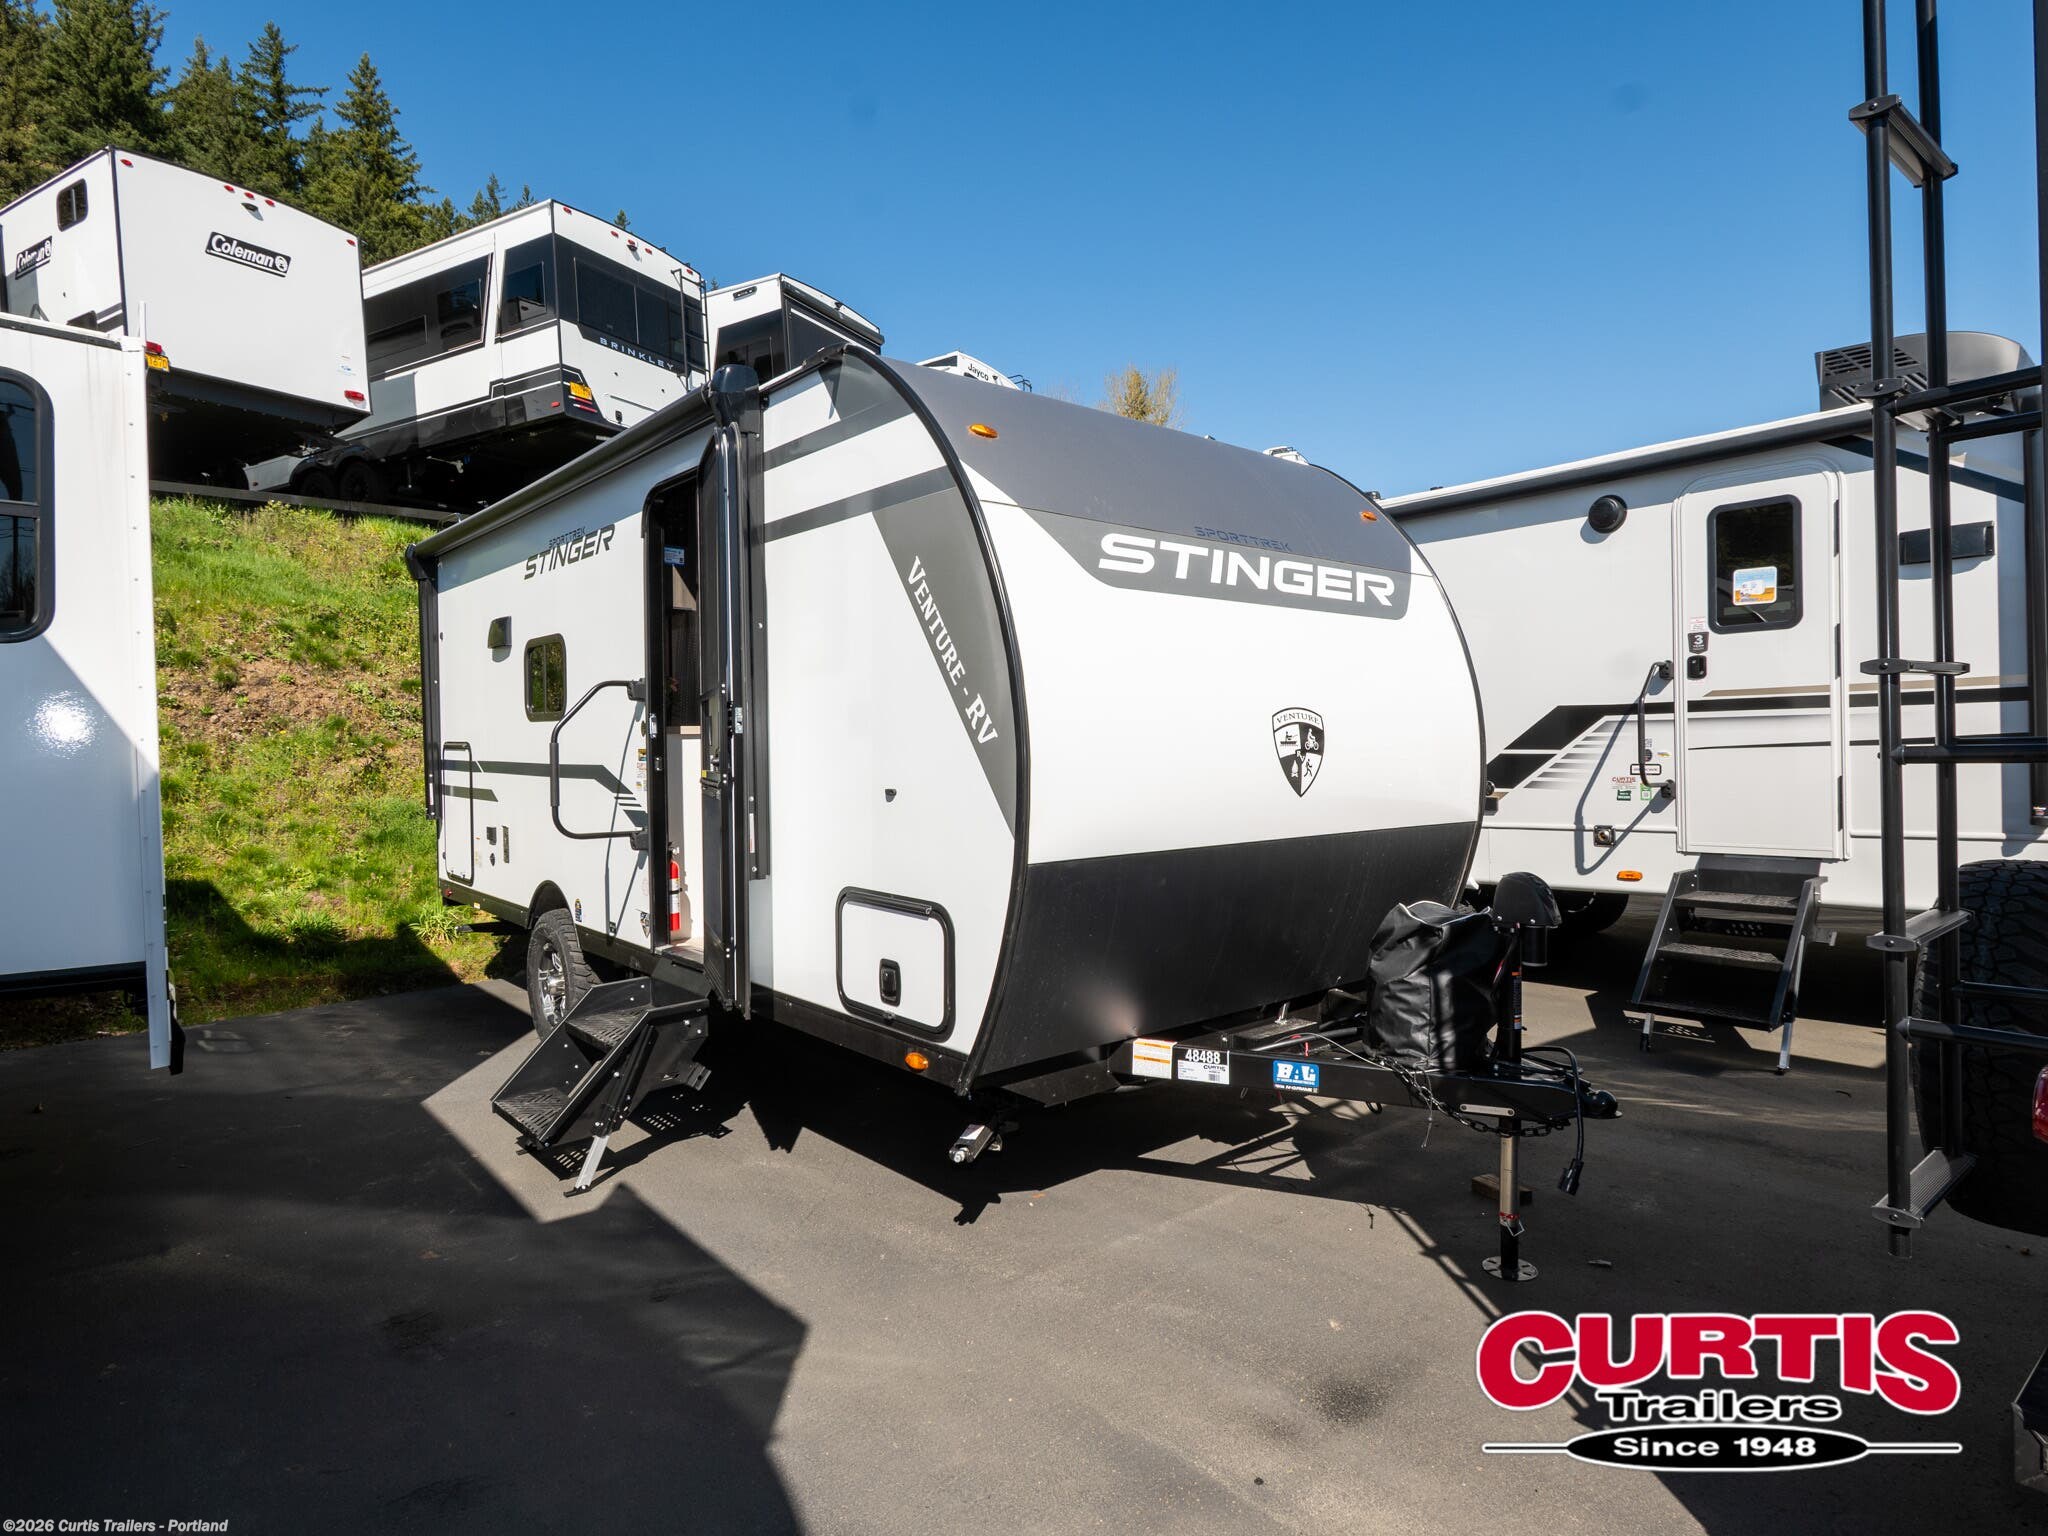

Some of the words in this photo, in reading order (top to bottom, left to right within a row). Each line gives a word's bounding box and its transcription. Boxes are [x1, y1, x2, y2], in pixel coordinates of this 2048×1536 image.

[211, 234, 275, 268] Coleman
[599, 337, 674, 370] BRINKLEY
[967, 363, 989, 381] Jayco
[523, 523, 616, 580] STINGER
[1193, 526, 1293, 551] SPORTTREK
[1098, 532, 1396, 607] STINGER
[907, 555, 966, 687] VENTURE
[965, 693, 998, 744] RV
[1693, 634, 1704, 645] 3
[1276, 712, 1321, 725] VENTURE
[1185, 1049, 1221, 1065] 48488
